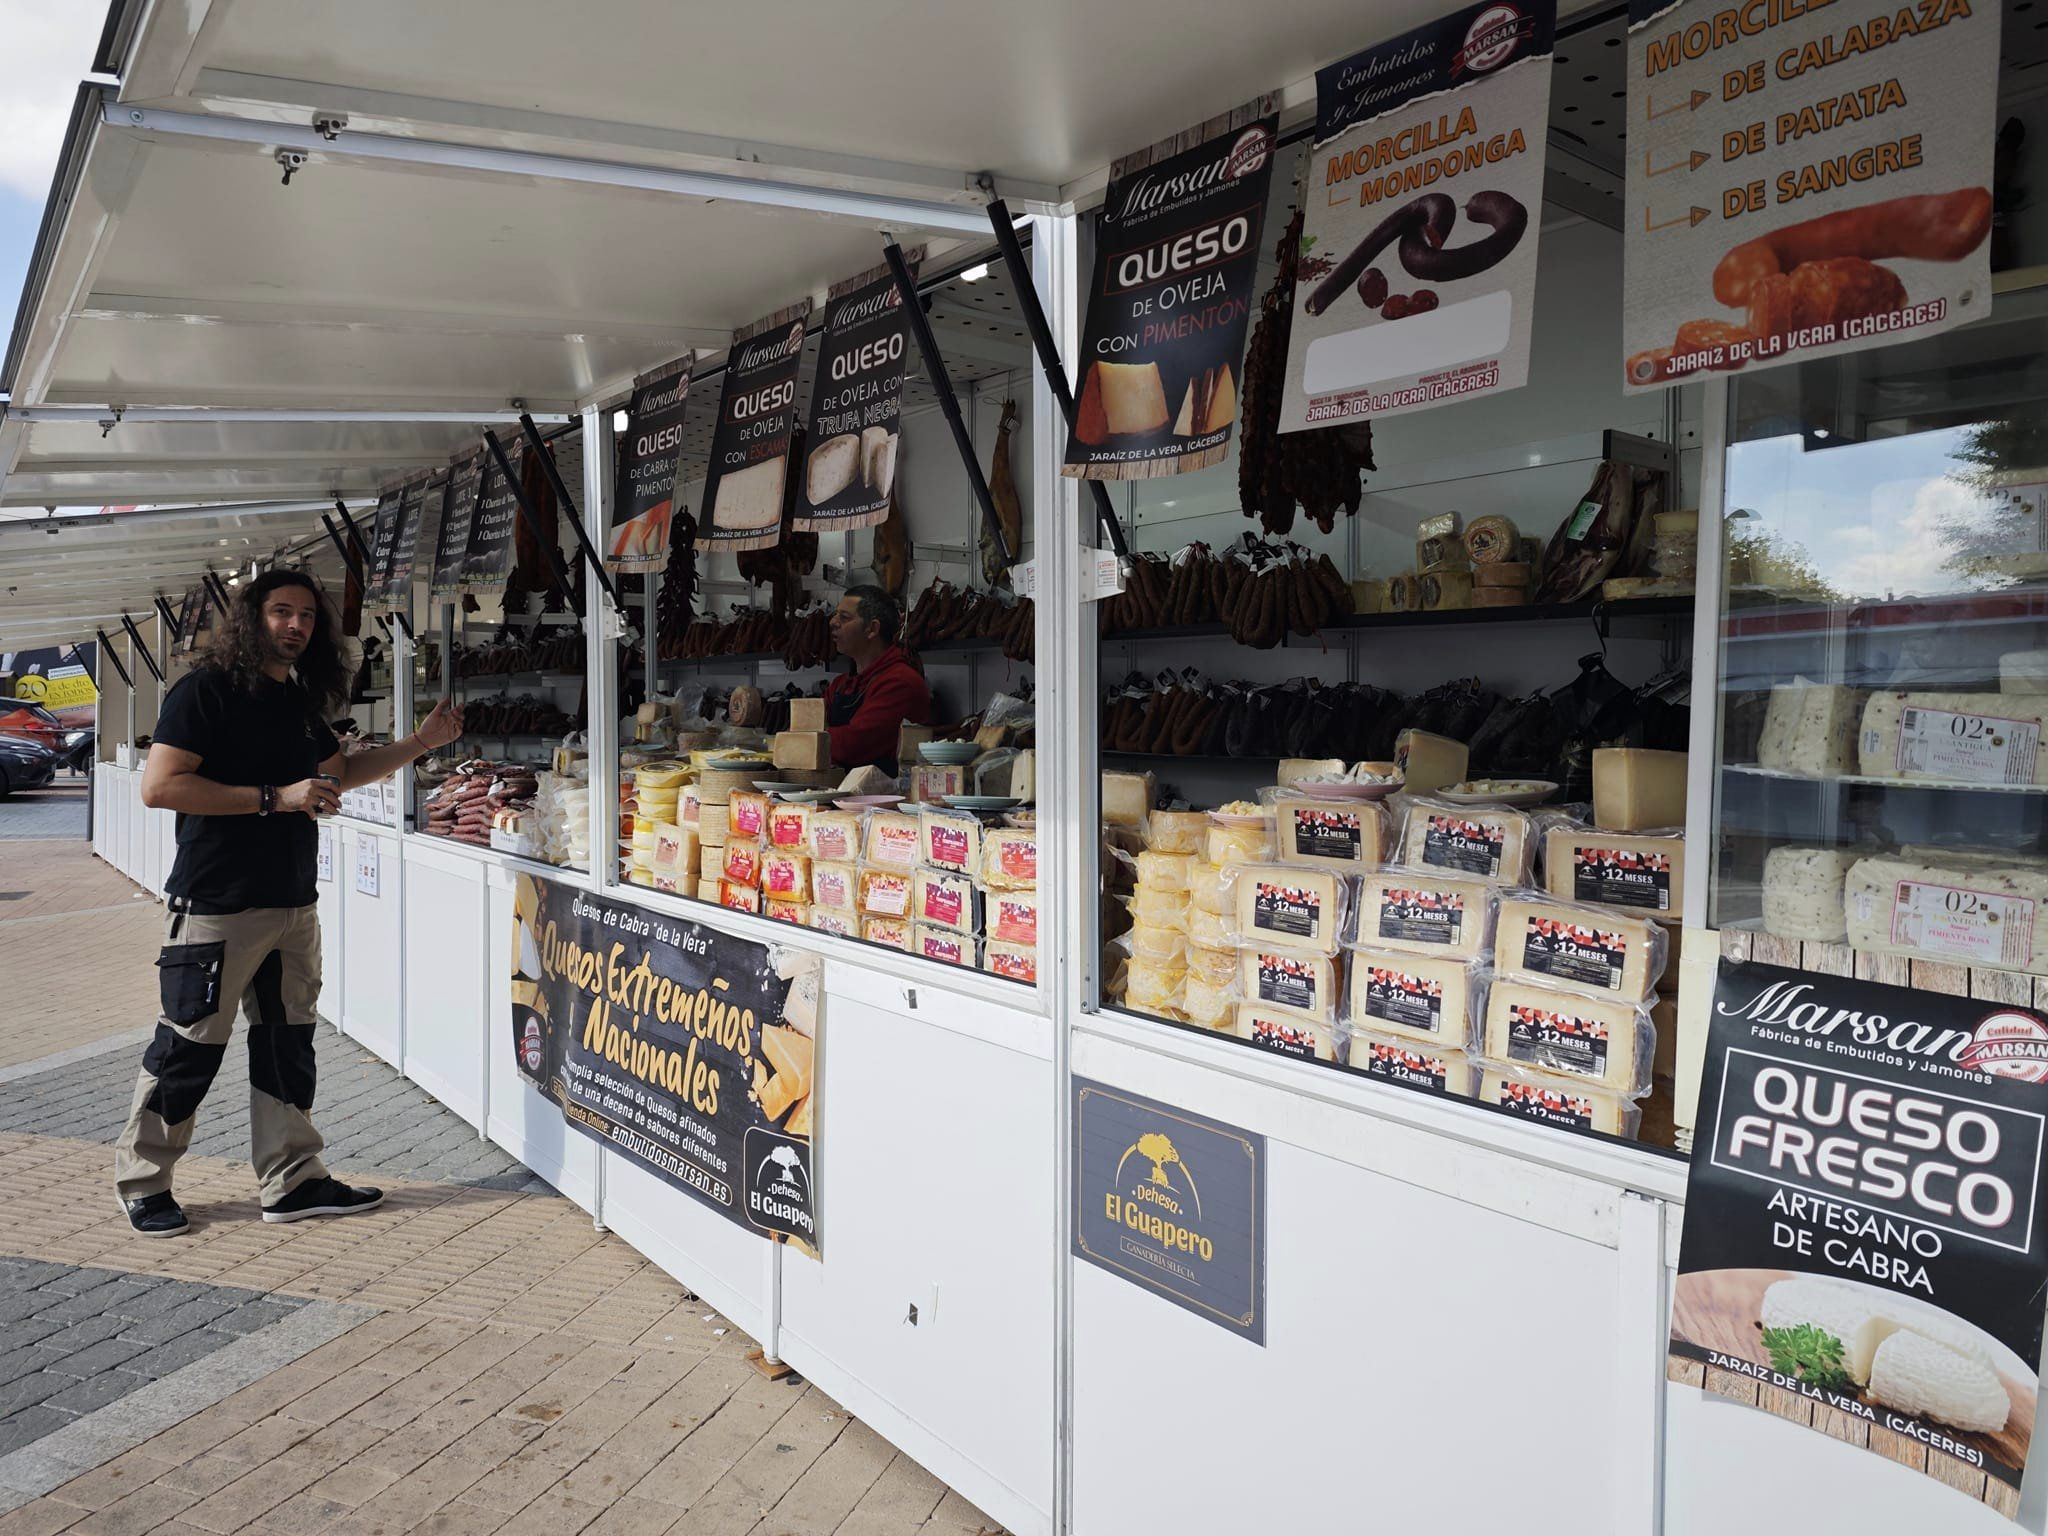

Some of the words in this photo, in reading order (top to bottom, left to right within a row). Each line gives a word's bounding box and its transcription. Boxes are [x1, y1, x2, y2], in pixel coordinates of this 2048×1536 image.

[1463, 22, 1519, 62] MARSAN
[1722, 61, 1766, 101] DE
[1776, 0, 1972, 79] CALABAZA
[1337, 39, 1436, 91] Embutidos
[1326, 104, 1345, 127] y
[1346, 69, 1436, 119] Jamones
[1722, 122, 1766, 162] DE
[1776, 79, 1906, 144] PATATA
[1325, 106, 1478, 186] MORCILLA
[1360, 128, 1527, 208] MONDONGA
[1722, 181, 1766, 219] DE
[1776, 134, 1923, 203] SANGRE
[1104, 156, 1231, 223] Marsan
[1150, 209, 1158, 218] de
[1160, 195, 1197, 214] Embutidos
[1205, 179, 1240, 197] Jamones
[1118, 216, 1249, 289] QUESO
[1132, 298, 1153, 319] DE
[1158, 271, 1226, 310] OVEJA
[831, 333, 903, 381] QUESO
[1096, 332, 1138, 355] CON
[1729, 341, 1754, 361] DE
[1756, 336, 1783, 356] LA
[1786, 324, 1837, 350] VERA
[734, 380, 795, 420] QUESO
[823, 397, 837, 411] DE
[840, 380, 880, 407] OVEJA
[1352, 398, 1370, 415] DE
[1372, 394, 1390, 411] LA
[1392, 387, 1426, 408] VERA
[637, 423, 682, 457] QUESO
[740, 428, 751, 441] DE
[753, 415, 784, 437] OVEJA
[817, 409, 861, 436] TRUFA
[725, 451, 747, 465] CON
[1089, 448, 1126, 463] JARAÍZ
[1128, 448, 1141, 460] DE
[1143, 446, 1155, 458] LA
[1157, 443, 1183, 456] VERA
[1187, 431, 1226, 452] (CÁCERES)
[630, 468, 641, 480] DE
[643, 458, 669, 477] CABRA
[838, 508, 846, 516] DE
[847, 507, 855, 515] LA
[17, 680, 47, 700] 20
[1951, 716, 1983, 739] 02
[1313, 826, 1330, 837] +12
[1330, 830, 1349, 839] MESES
[1447, 836, 1466, 850] +12
[1467, 841, 1489, 854] MESES
[1601, 868, 1624, 881] +12
[1624, 872, 1653, 884] MESES
[572, 897, 601, 922] Quesos
[603, 911, 616, 927] de
[619, 912, 650, 938] Cabra
[671, 927, 681, 944] la
[1273, 901, 1289, 912] +12
[1289, 906, 1309, 917] MESES
[1403, 907, 1423, 920] +12
[1423, 911, 1449, 922] MESES
[1945, 891, 1977, 915] 02
[1553, 941, 1577, 955] +12
[1577, 949, 1608, 962] MESES
[1928, 929, 1967, 941] PIMIENTA
[1968, 935, 1990, 945] ROSA
[541, 921, 604, 994] Quesos
[606, 941, 755, 1058] Extremeños
[1275, 973, 1289, 984] +12
[1289, 978, 1306, 988] MESES
[1387, 988, 1406, 1002] +12
[1406, 995, 1429, 1008] MESES
[1536, 1030, 1561, 1044] +12
[1561, 1036, 1591, 1051] MESES
[1716, 980, 1985, 1063] Marsan
[582, 996, 721, 1116] Nacionales
[1751, 1026, 1802, 1046] Fábrica
[1804, 1038, 1822, 1050] de
[1826, 1041, 1903, 1067] Embutidos
[1908, 1059, 1917, 1072] y
[1920, 1061, 1993, 1086] Jamones
[1976, 1042, 2048, 1060] MARSAN
[1390, 1066, 1409, 1079] +12
[1409, 1072, 1433, 1086] MESES
[573, 1080, 582, 1094] de
[585, 1087, 601, 1103] una
[603, 1094, 634, 1120] decena
[635, 1110, 645, 1126] de
[646, 1118, 680, 1146] sabores
[682, 1137, 728, 1174] diferentes
[594, 1074, 634, 1101] selección
[635, 1089, 645, 1106] de
[646, 1096, 678, 1124] Quesos
[678, 1112, 717, 1147] afinados
[1753, 1067, 2001, 1165] QUESO
[587, 1112, 610, 1134] Online:
[611, 1126, 728, 1202] embutidosmarsan.es
[1729, 1114, 2014, 1230] FRESCO
[771, 1183, 801, 1202] Dehesa
[1137, 1184, 1178, 1214] Dehesa
[750, 1191, 762, 1211] El
[762, 1196, 814, 1235] Guapero
[1105, 1193, 1121, 1223] El
[1124, 1201, 1214, 1262] Guapero
[1767, 1188, 1943, 1259] ARTESANO
[1773, 1221, 1813, 1256] DE
[1823, 1239, 1935, 1295] CABRA
[1708, 1350, 1770, 1383] JARAÍZ
[1773, 1372, 1797, 1391] DE
[1801, 1383, 1823, 1400] LA
[1828, 1393, 1876, 1421] VERA
[1884, 1413, 1984, 1468] (CÁCERES)
